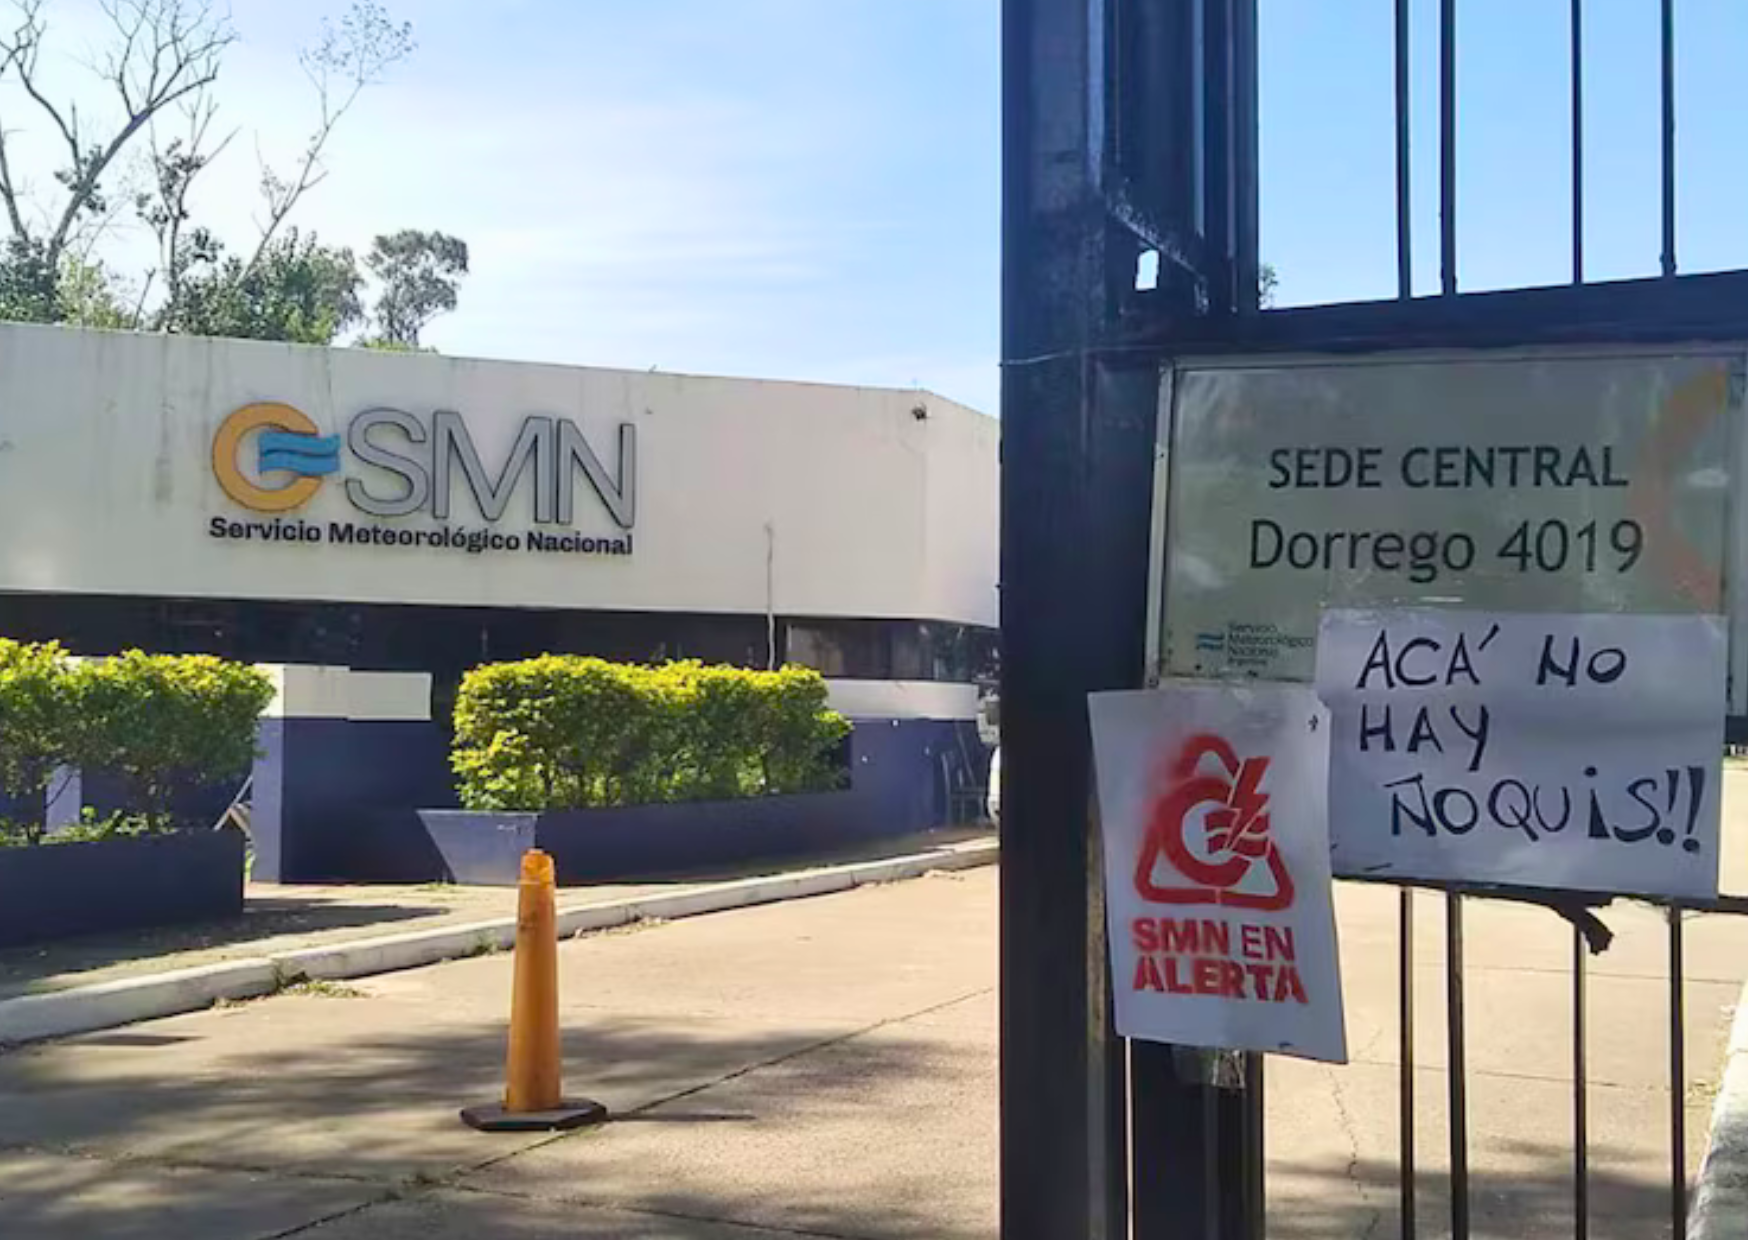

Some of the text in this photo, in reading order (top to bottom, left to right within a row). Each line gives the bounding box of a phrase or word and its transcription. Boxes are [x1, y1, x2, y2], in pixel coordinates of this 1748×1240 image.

[344, 406, 636, 529] SMN
[1268, 445, 1629, 488] SEDE CENTRAL
[209, 517, 633, 555] Servicio Meteorológico Nacional
[1249, 518, 1643, 583] Dorrego 4019
[1356, 623, 1627, 689] ACÁ NO
[1359, 703, 1490, 771] HAY
[1133, 918, 1295, 961] SMN EN
[1133, 957, 1308, 1003] ALERTA
